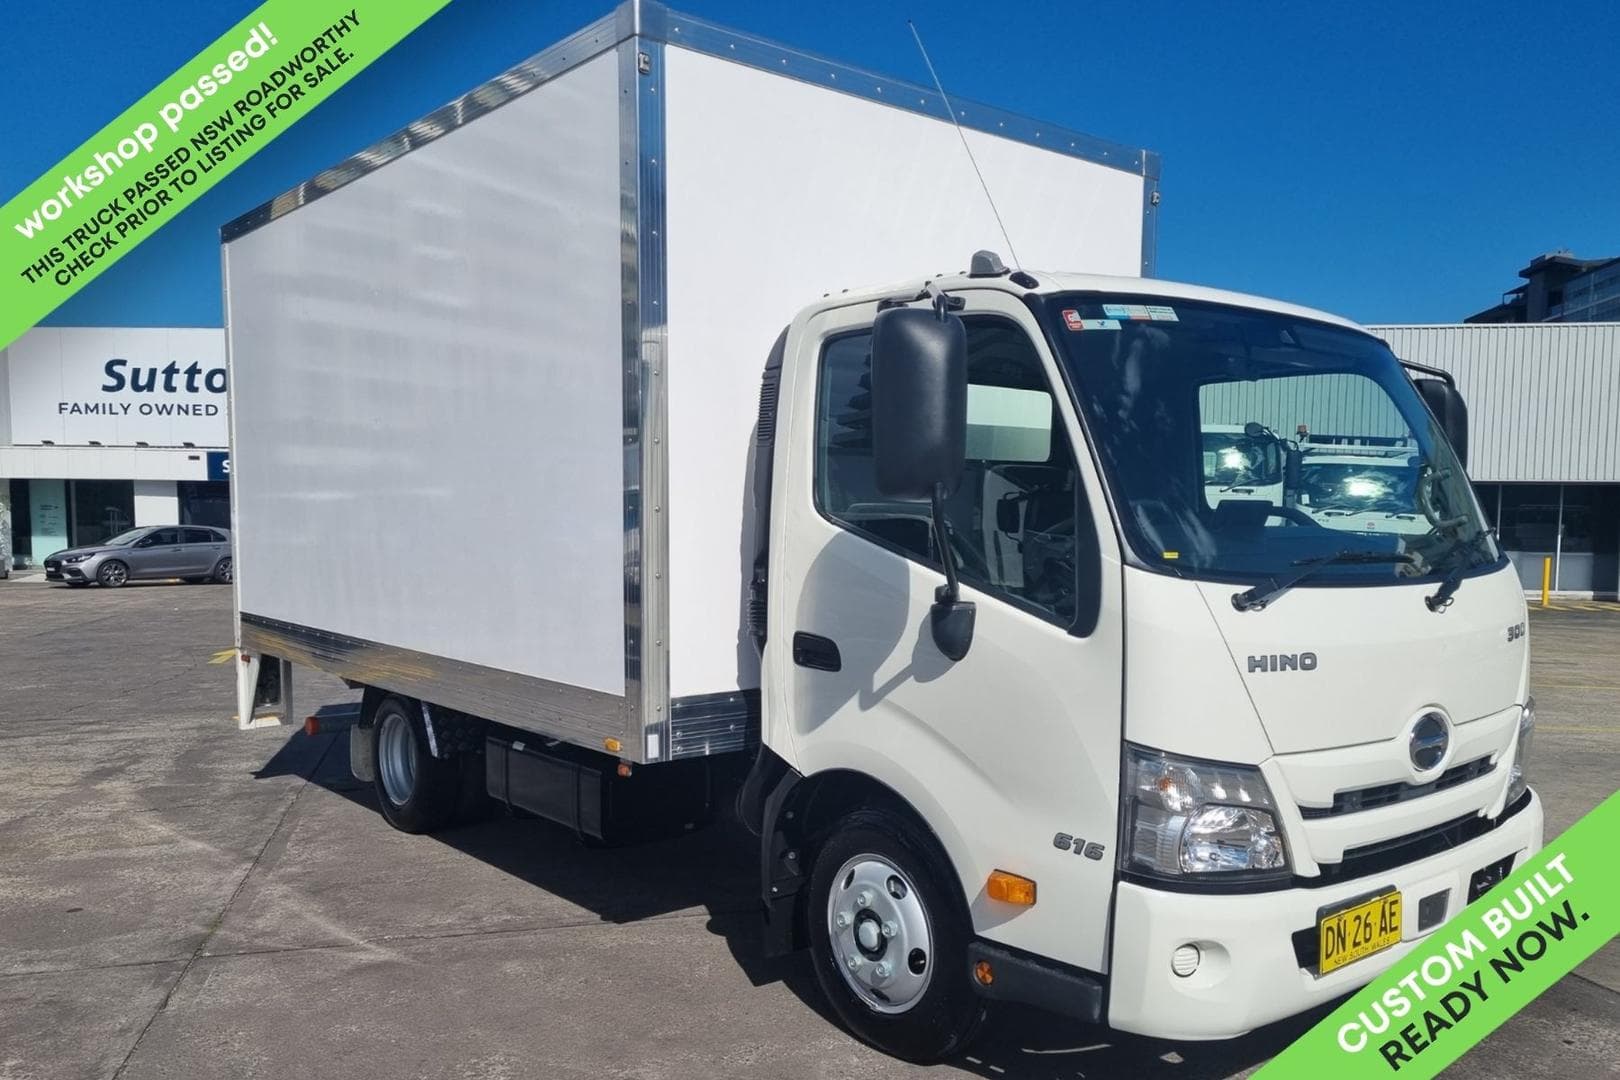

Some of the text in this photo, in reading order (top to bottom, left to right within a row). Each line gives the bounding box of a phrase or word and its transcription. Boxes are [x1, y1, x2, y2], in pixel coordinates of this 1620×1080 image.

[101, 359, 227, 393] Sutto
[58, 402, 218, 416] FAMILY OWNED
[1507, 621, 1525, 642] 300
[1248, 652, 1317, 673] HINO
[1053, 832, 1105, 861] 616
[1325, 899, 1399, 961] DN 26 AE
